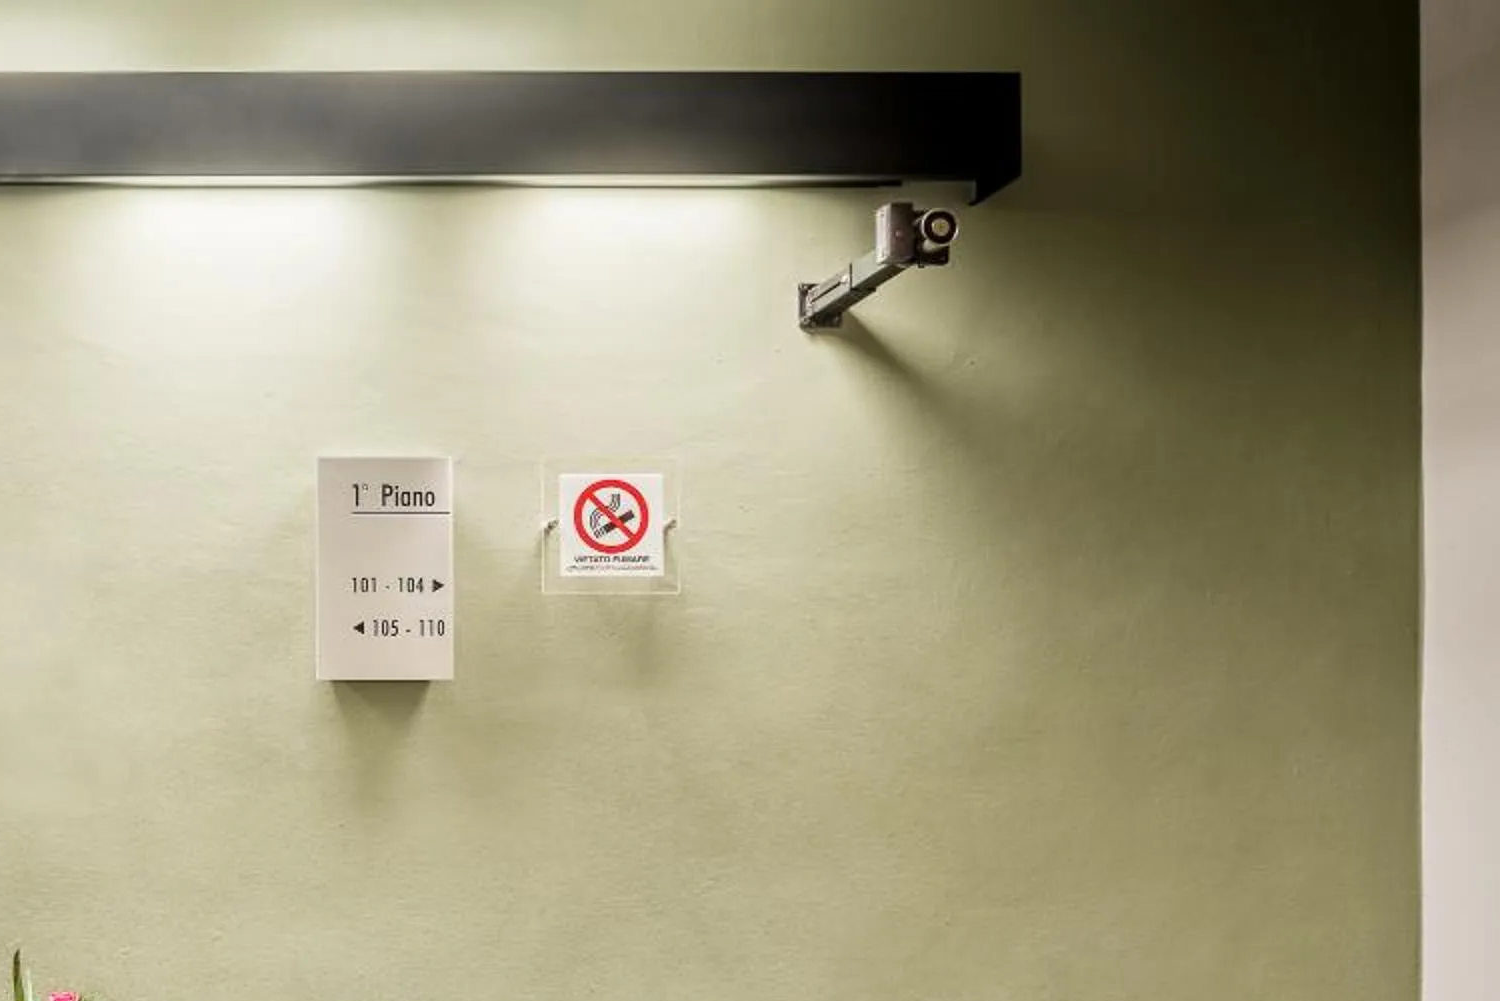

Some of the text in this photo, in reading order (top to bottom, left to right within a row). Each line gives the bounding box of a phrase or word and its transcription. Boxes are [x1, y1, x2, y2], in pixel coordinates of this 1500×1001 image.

[381, 483, 435, 507] Piano
[352, 577, 377, 593] 101
[398, 577, 424, 593] 104
[373, 619, 399, 637] 105
[419, 619, 445, 637] 110
